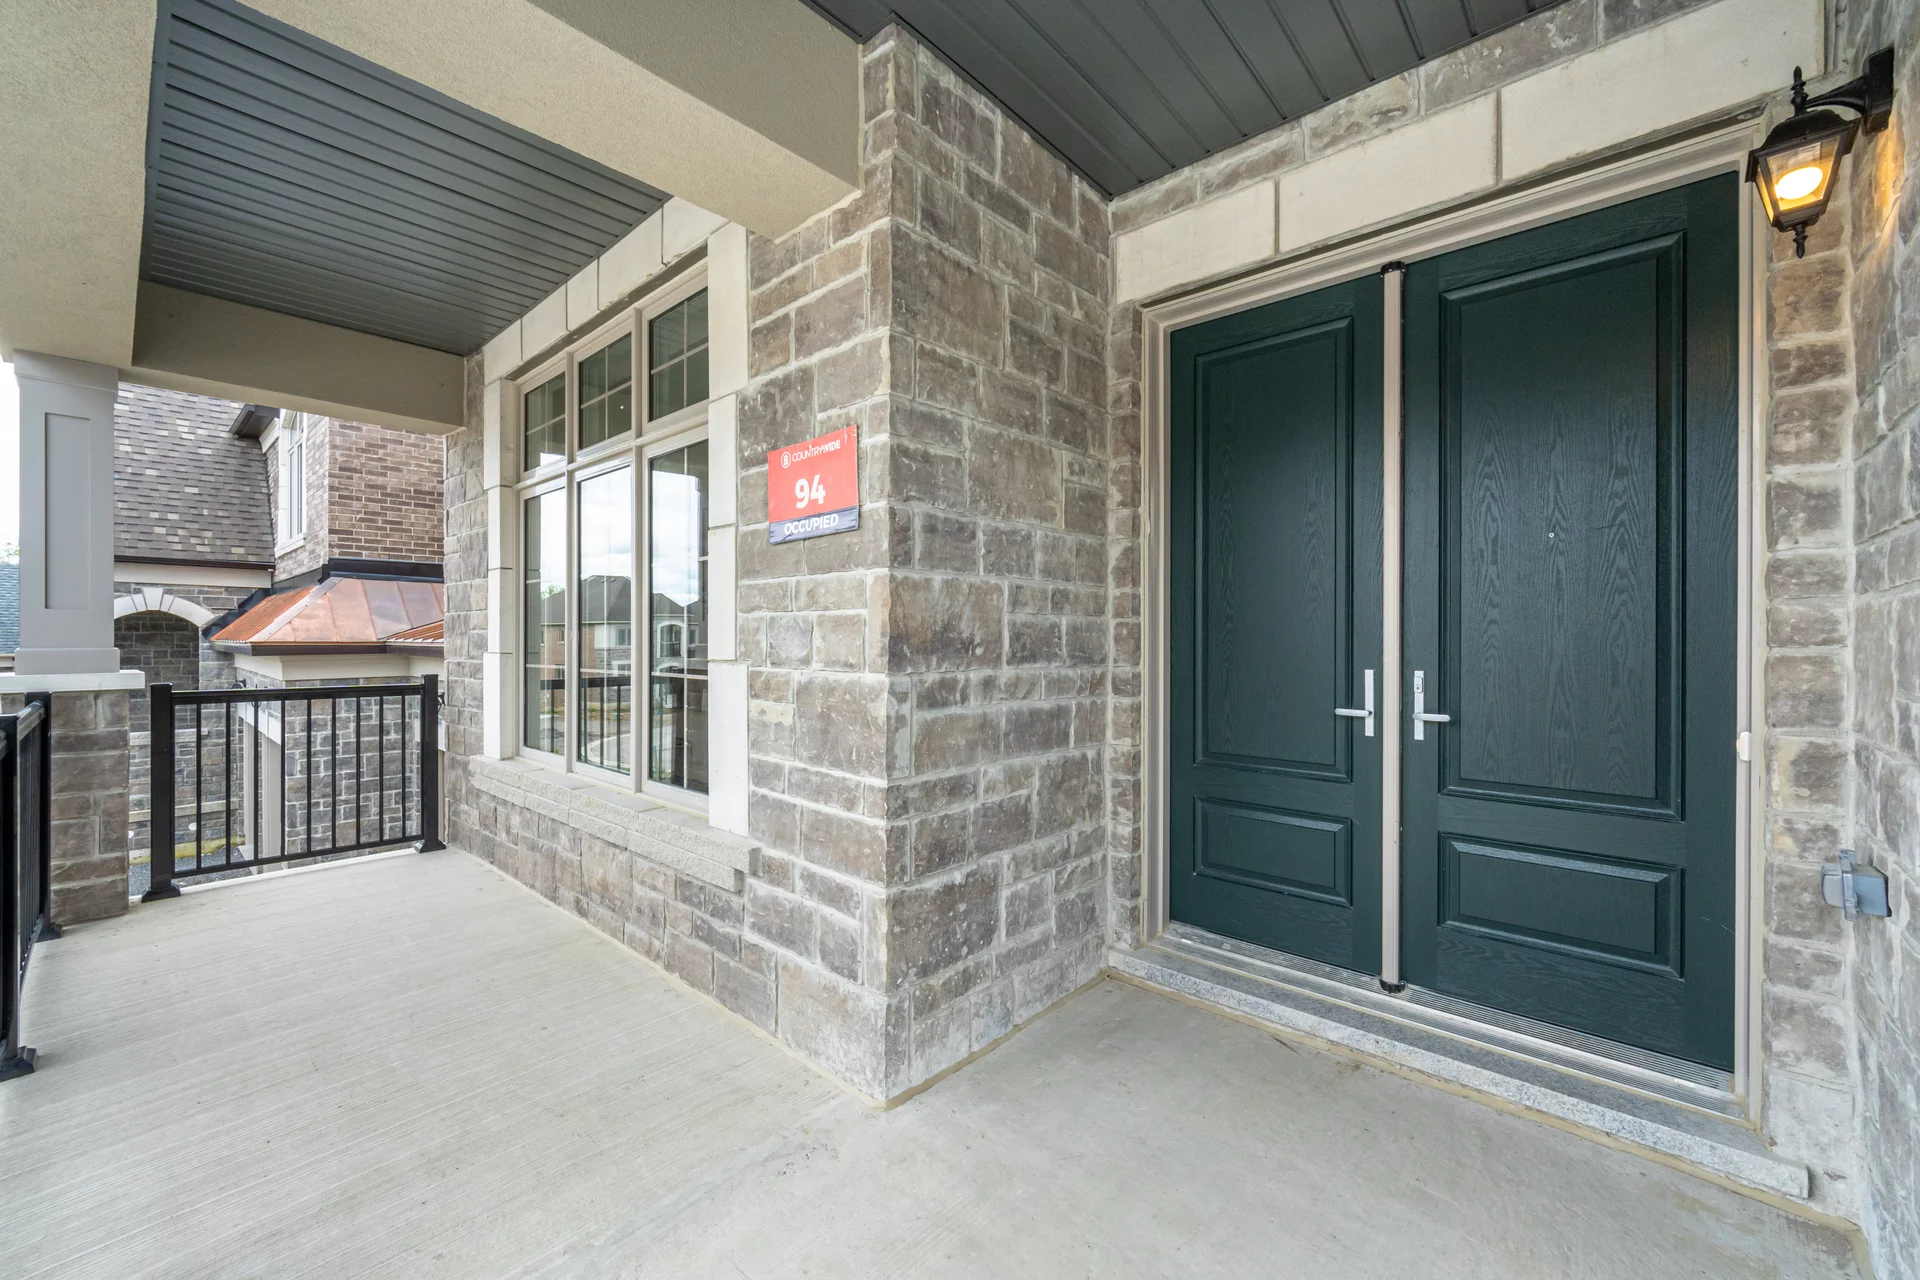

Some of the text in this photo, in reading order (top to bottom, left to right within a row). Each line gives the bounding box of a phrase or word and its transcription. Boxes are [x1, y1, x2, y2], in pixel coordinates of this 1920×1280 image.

[791, 439, 841, 462] COUNTRYWIDE
[794, 474, 826, 509] 94
[783, 513, 839, 536] OCCUPIED
